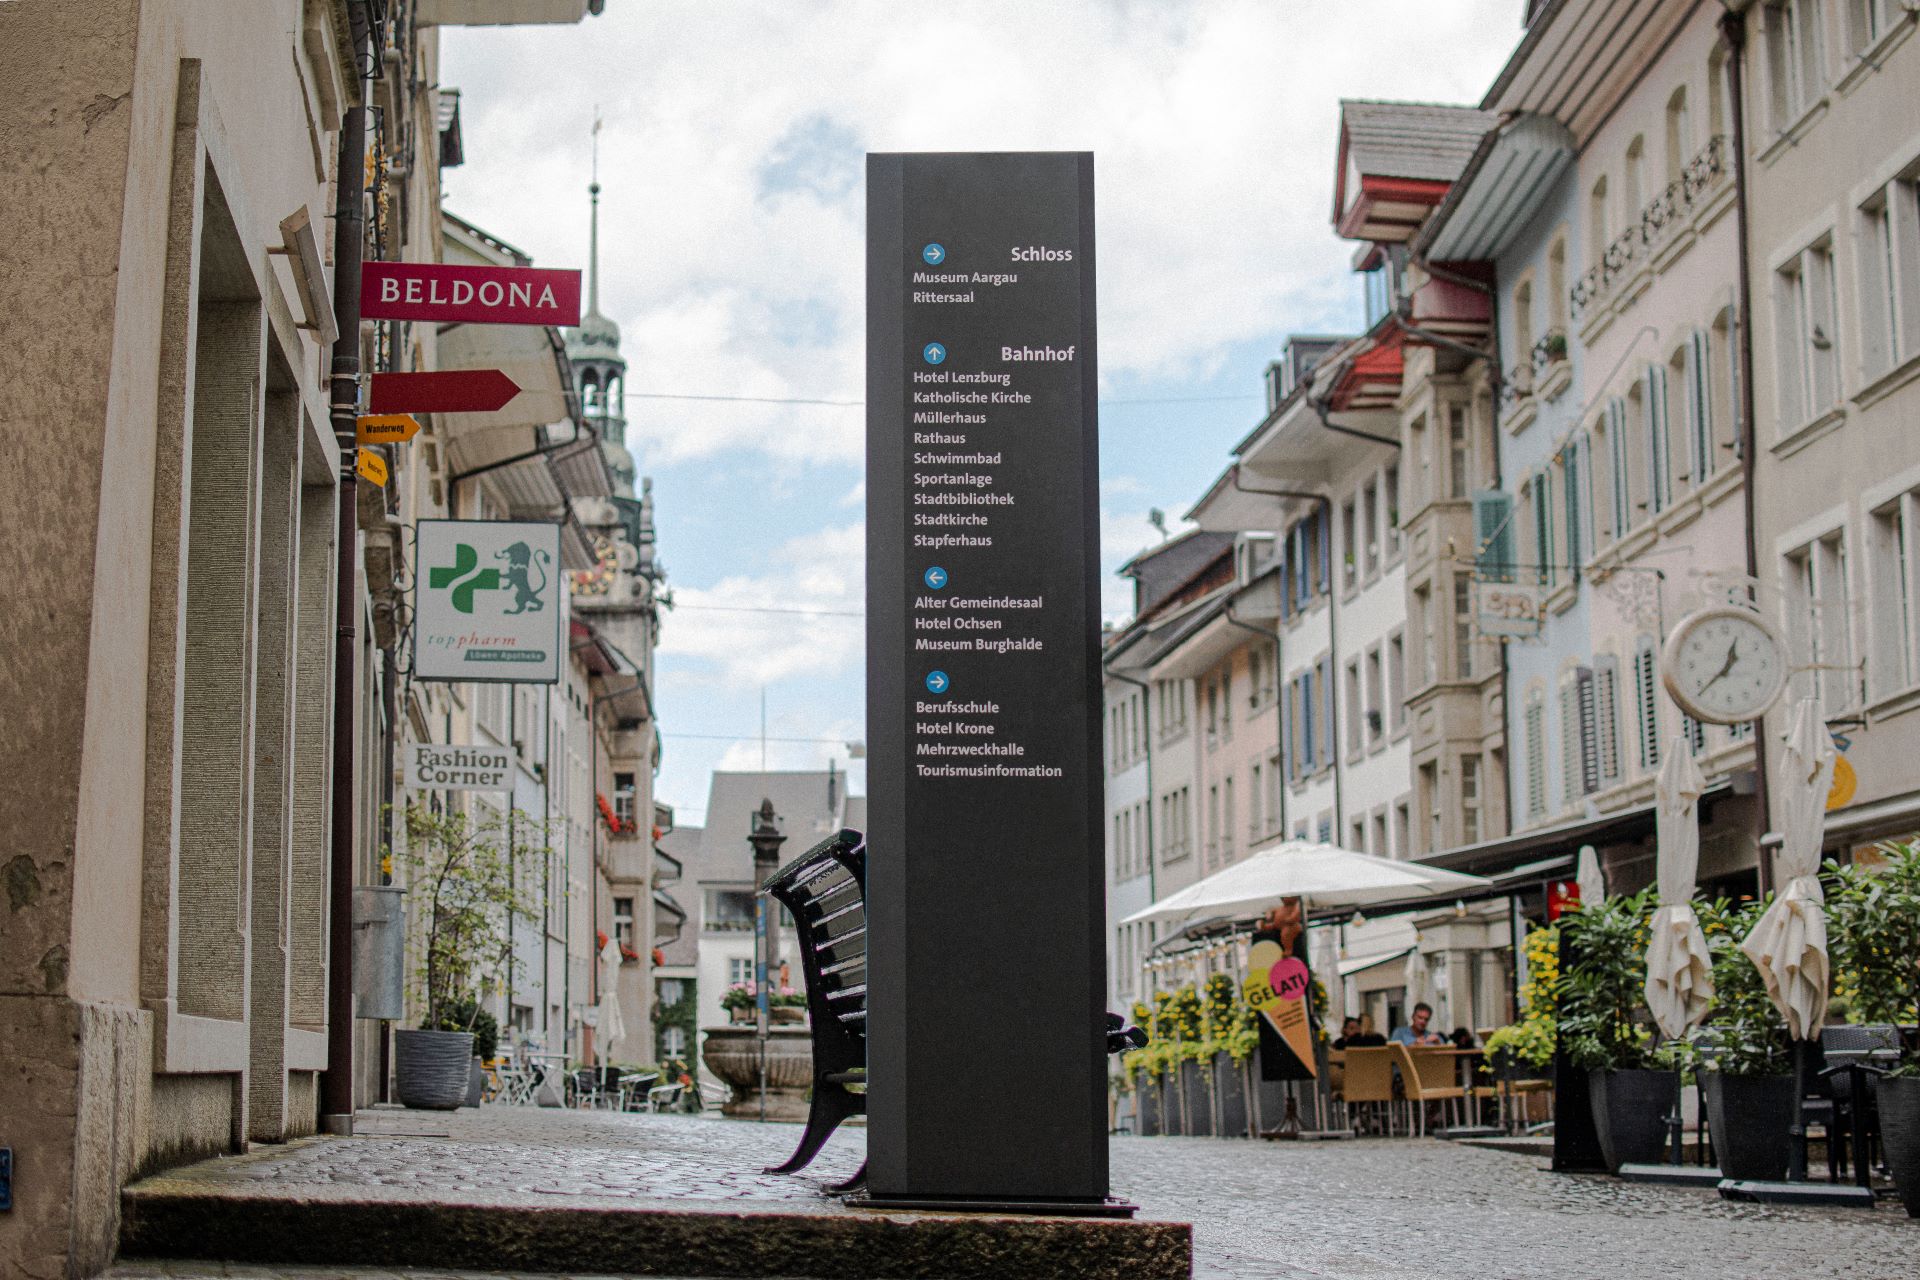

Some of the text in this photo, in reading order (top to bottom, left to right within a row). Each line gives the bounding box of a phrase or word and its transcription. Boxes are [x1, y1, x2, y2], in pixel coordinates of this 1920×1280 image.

[1010, 245, 1073, 262] Schloss
[912, 271, 1018, 287] Museum Aargau
[381, 277, 558, 309] BELDONA
[913, 290, 975, 304] Rittersaal
[1001, 345, 1076, 362] Bahnhof
[913, 370, 1011, 387] Hotel Lenzburg
[913, 390, 1032, 404] Katholische Kirche
[913, 411, 987, 424] Müllerhaus
[914, 431, 966, 444] Rathaus
[913, 451, 1002, 465] Schwimmbad
[913, 472, 993, 488] Sportanlage
[914, 492, 1015, 505] Stadtbibliothek
[913, 512, 989, 526] Stadtkirche
[913, 533, 993, 550] Stapferhaus
[914, 595, 1043, 609] Alter Gemeindesaal
[915, 616, 1002, 630] Hotel Ochsen
[428, 631, 517, 648] toppharm
[915, 637, 1043, 654] Museum Burghalde
[916, 700, 1000, 714] Berufsschule
[916, 721, 995, 735] Hotel Krone
[916, 742, 1025, 756] Mehrzweckhalle
[416, 748, 508, 768] Fashion
[418, 765, 504, 785] Corner
[916, 763, 1062, 777] Tourismusinformation
[1249, 973, 1305, 1006] GELATI
